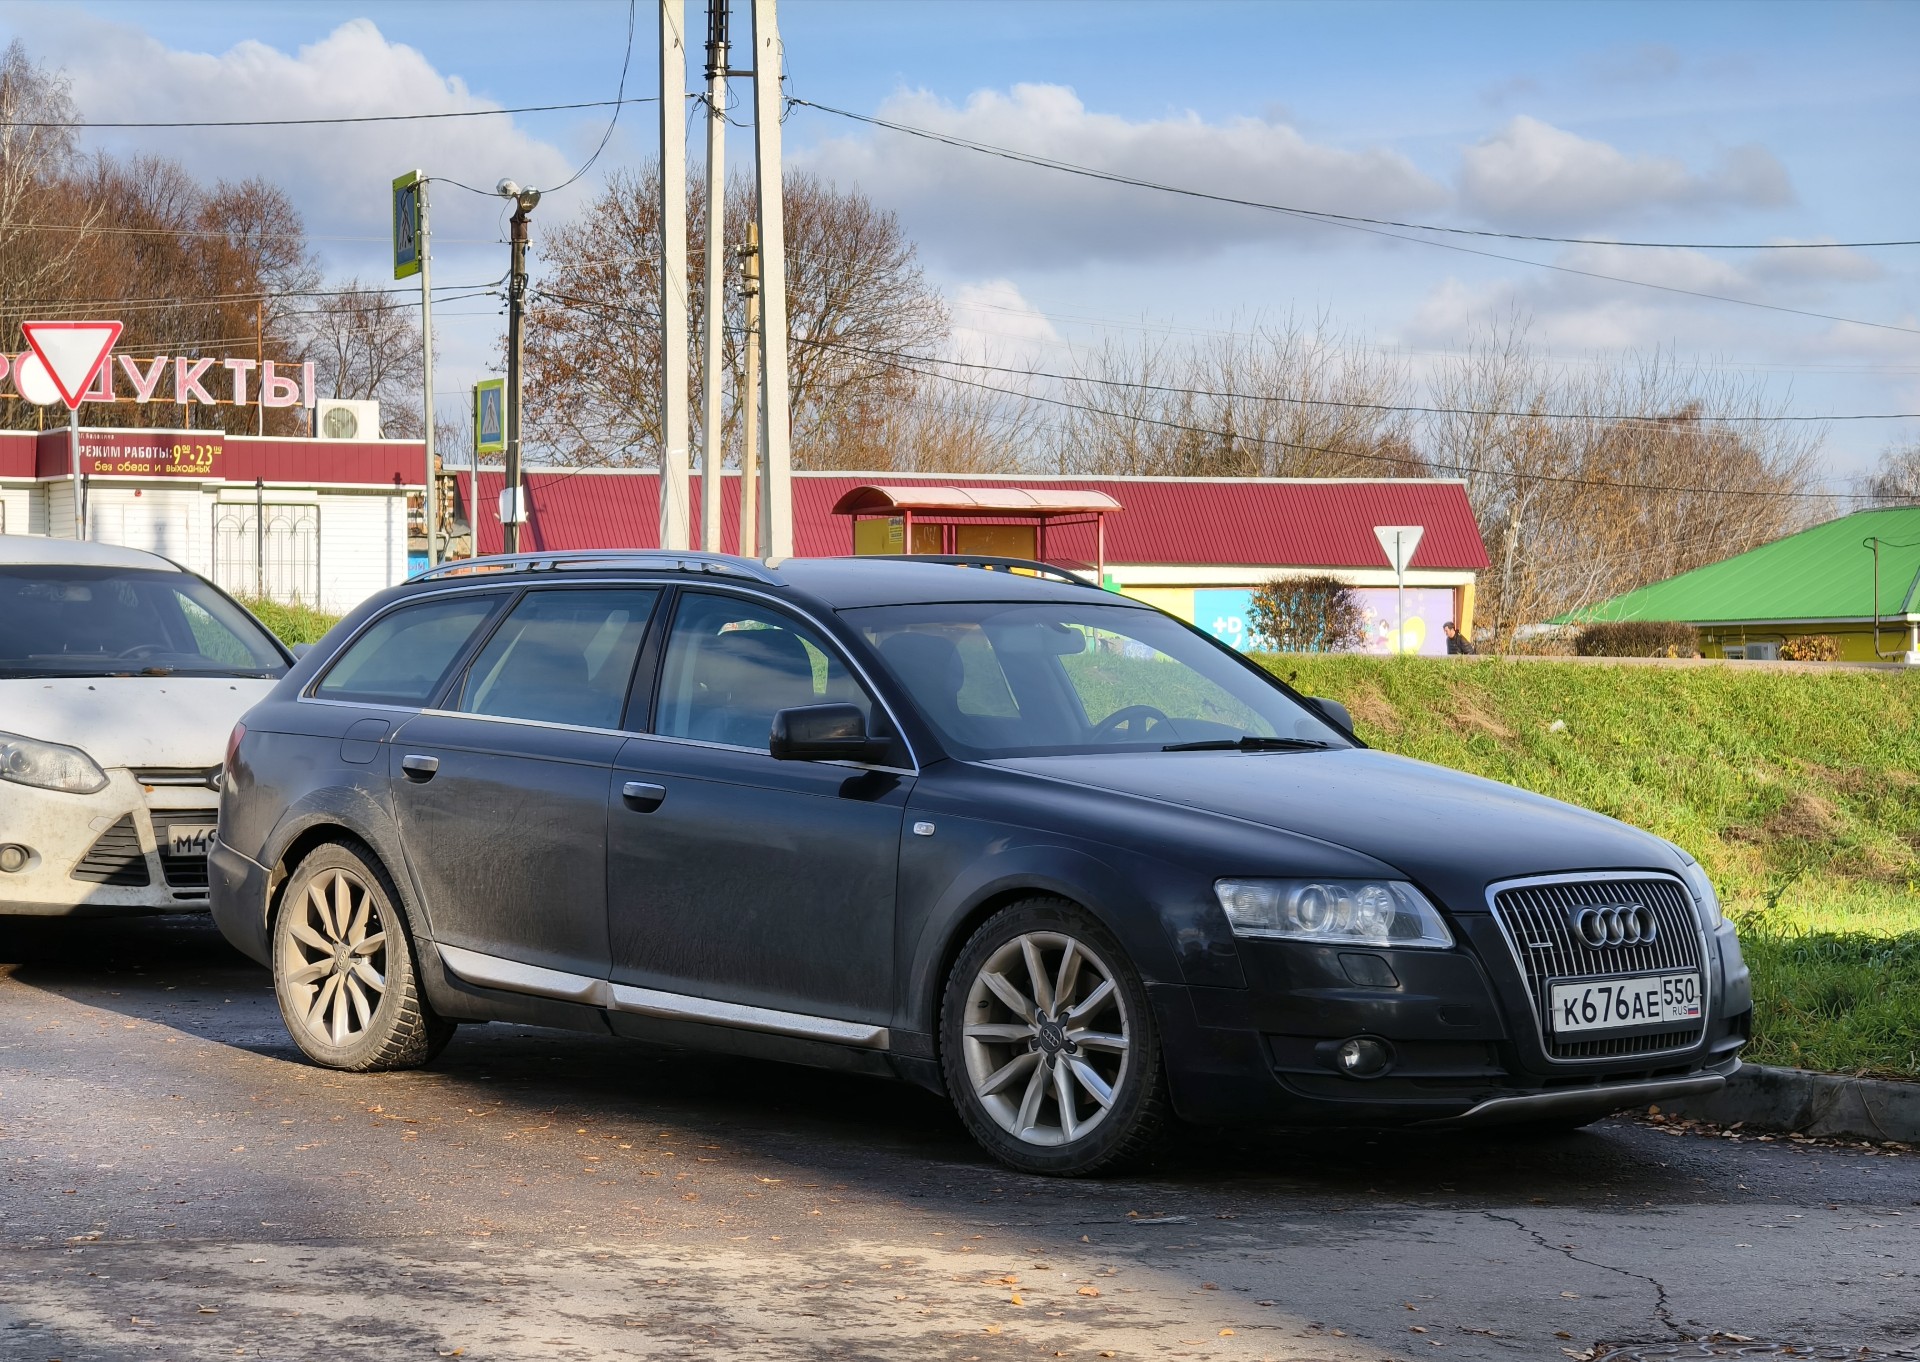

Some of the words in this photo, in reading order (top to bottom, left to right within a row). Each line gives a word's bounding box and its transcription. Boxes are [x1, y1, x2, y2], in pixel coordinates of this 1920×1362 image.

[79, 445, 121, 458] РЕЖИМ
[124, 446, 173, 460] РАБОТЫ:
[94, 460, 113, 472] без
[117, 461, 150, 472] обеда
[154, 464, 161, 472] и
[165, 464, 211, 474] выходных
[1663, 977, 1695, 1006] 550
[1672, 1005, 1688, 1016] RUS
